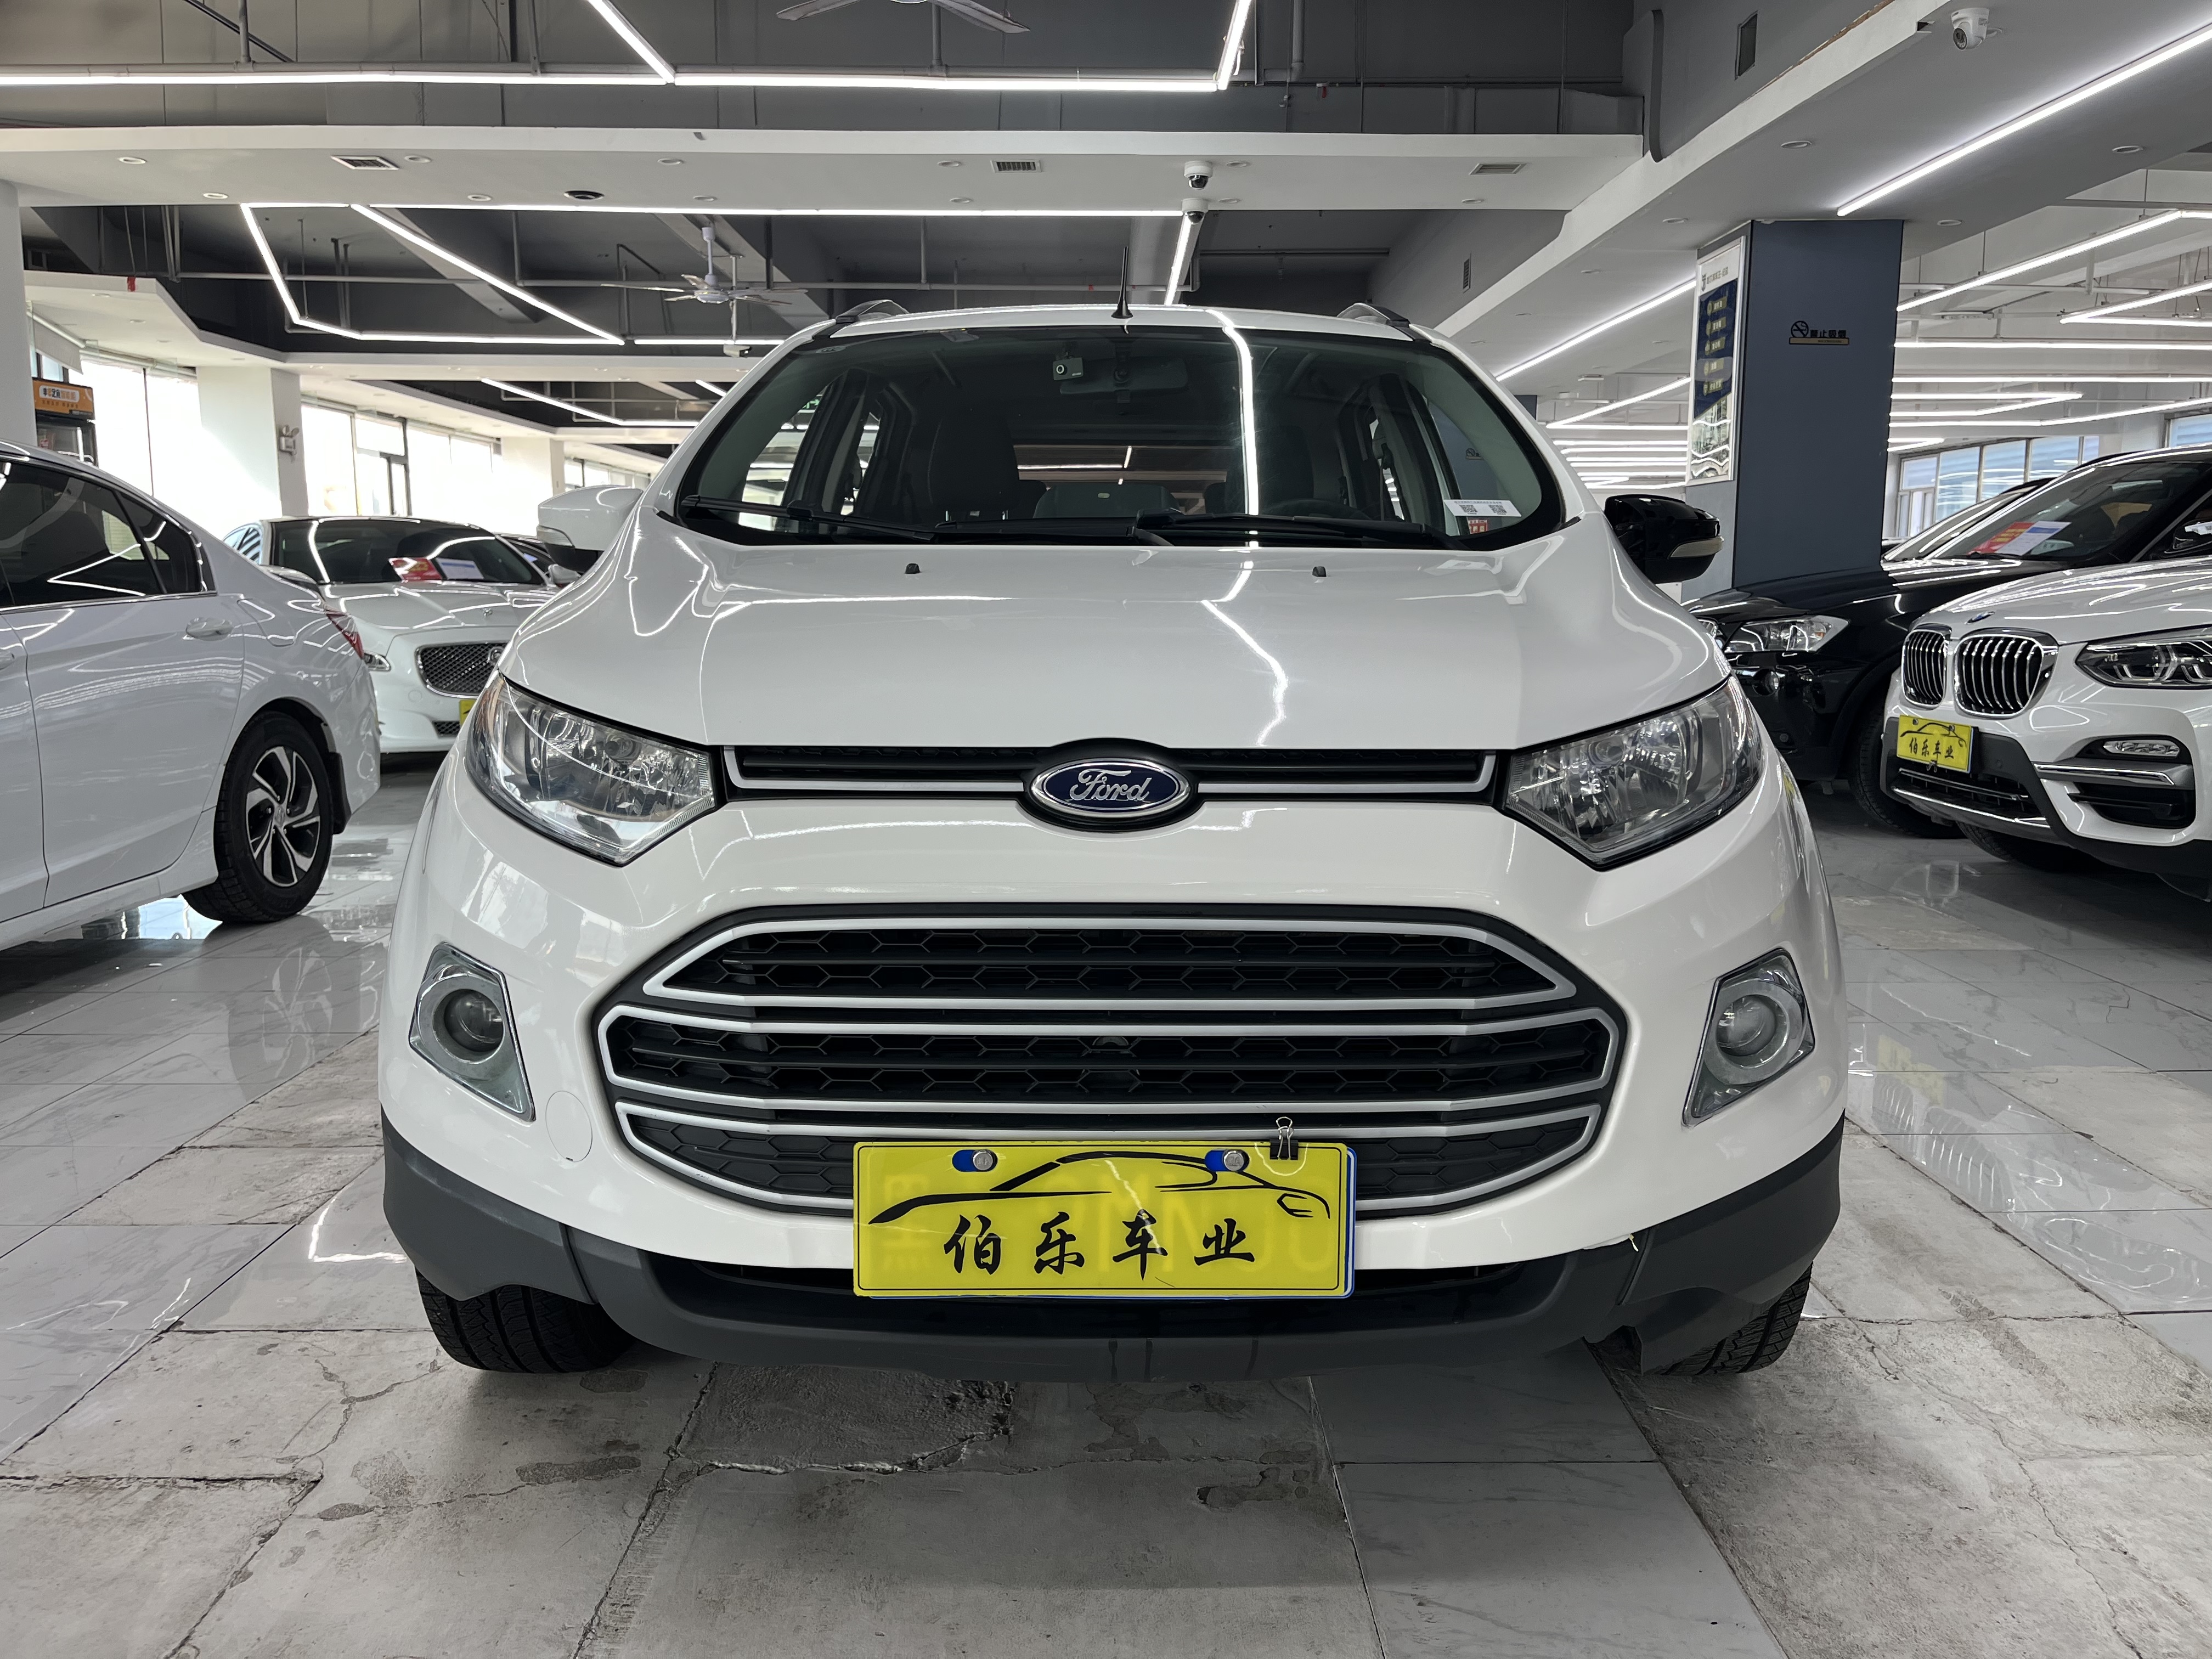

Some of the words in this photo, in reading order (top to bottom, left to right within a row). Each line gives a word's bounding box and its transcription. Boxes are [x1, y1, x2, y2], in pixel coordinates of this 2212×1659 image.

[1909, 737, 1954, 760] 伯乐车业
[1069, 768, 1152, 800] Ford
[943, 1209, 1255, 1280] 伯乐车业
